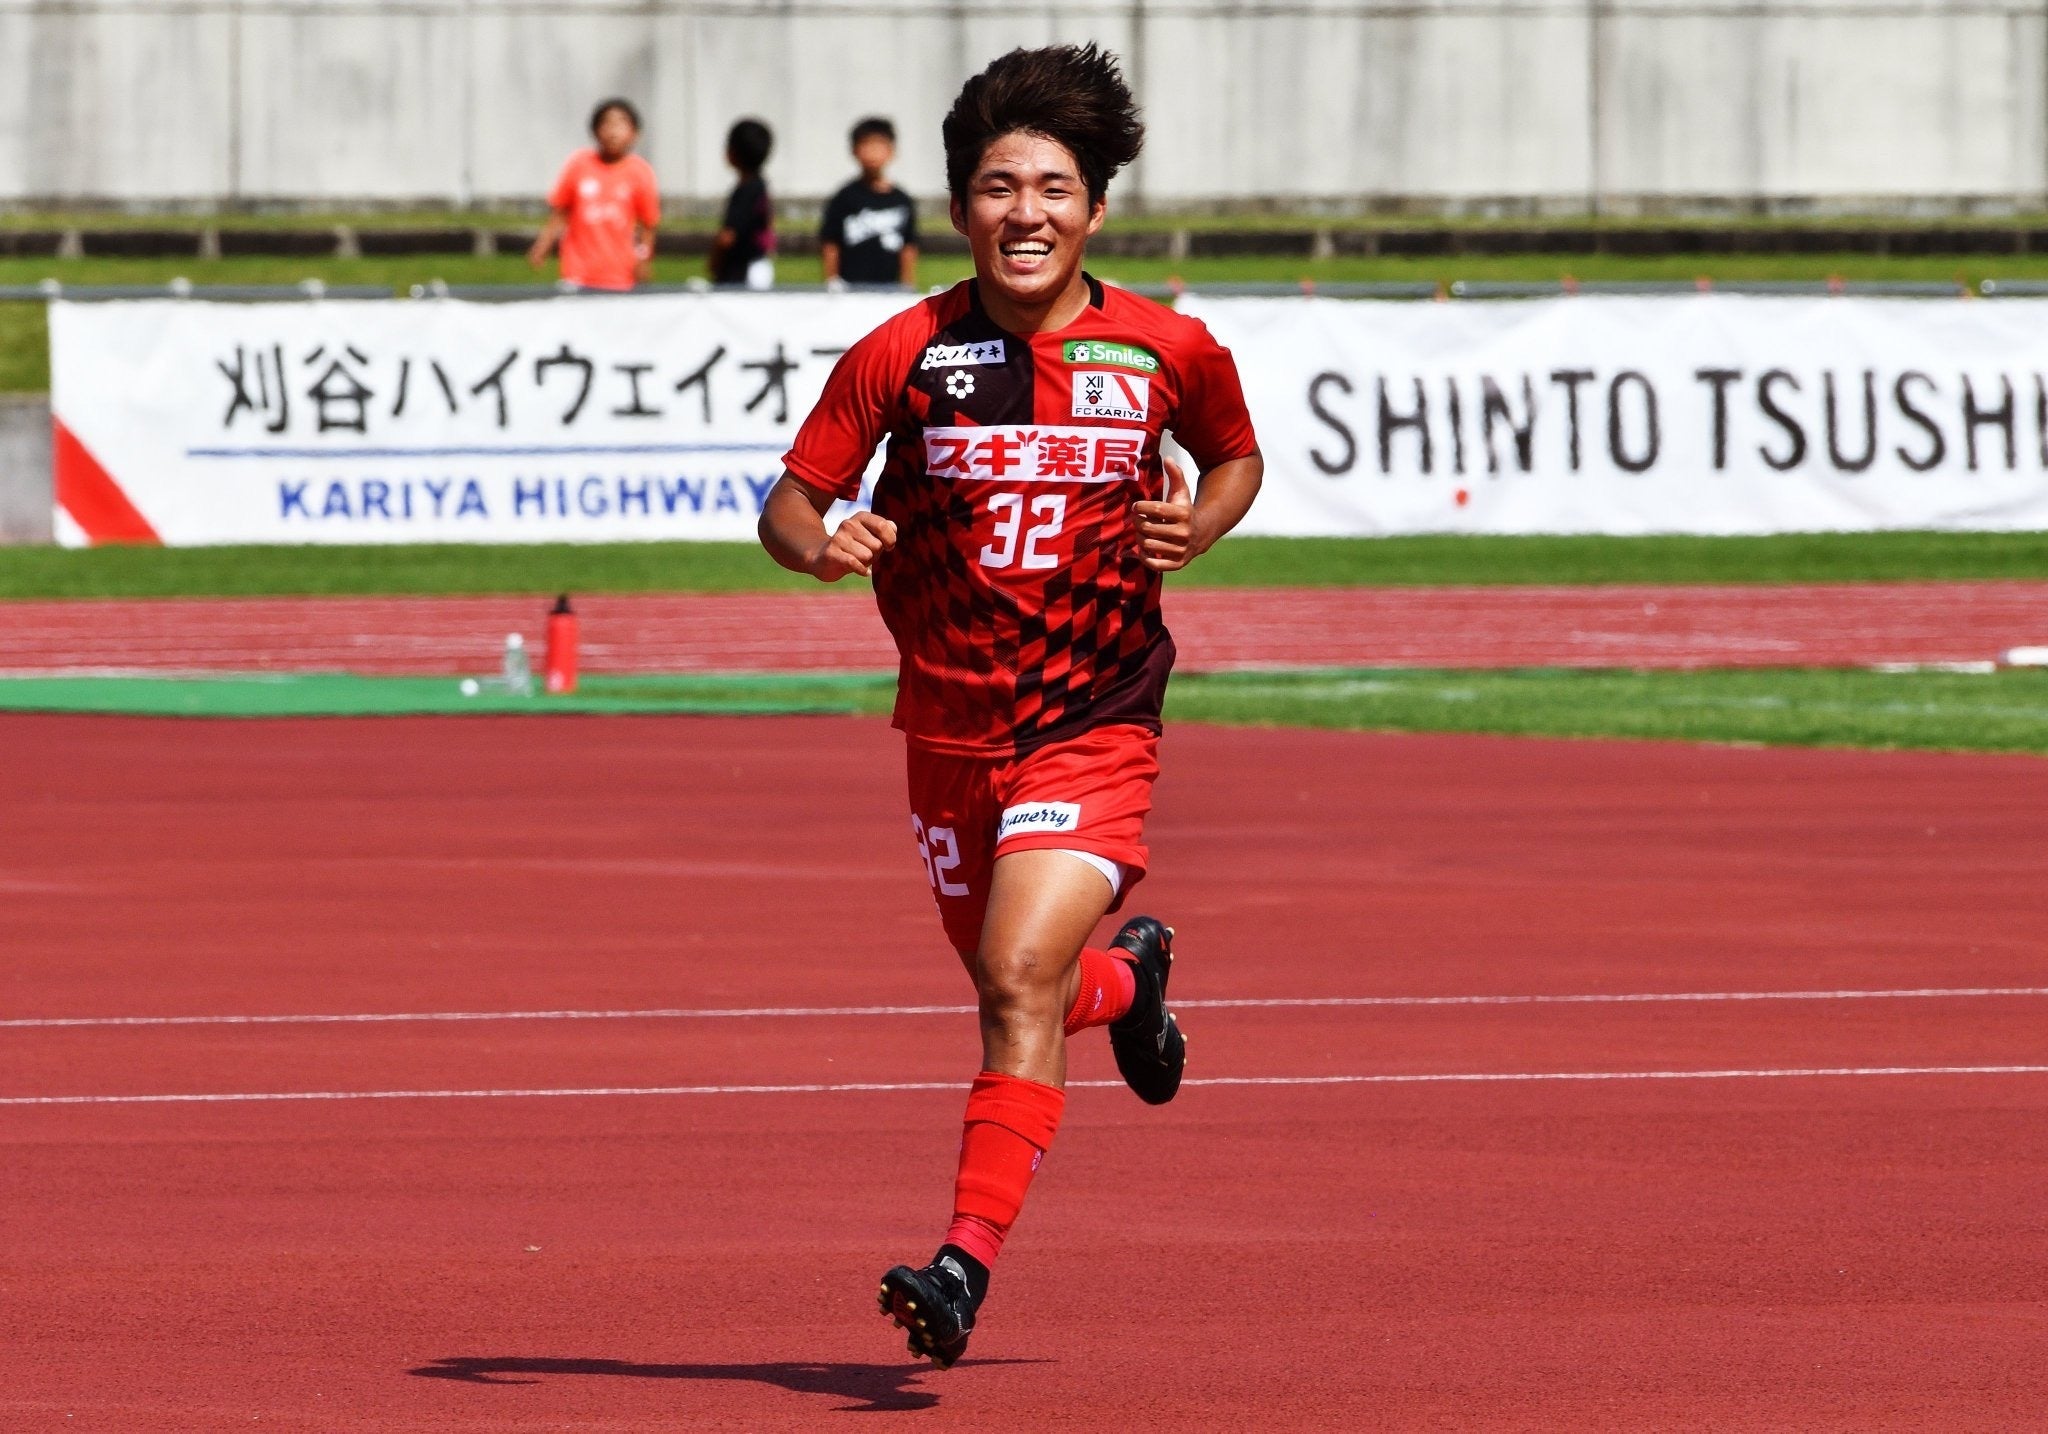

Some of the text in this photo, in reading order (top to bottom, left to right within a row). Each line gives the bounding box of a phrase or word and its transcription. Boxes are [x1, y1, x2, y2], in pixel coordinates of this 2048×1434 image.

[1092, 344, 1156, 370] Smiles
[217, 343, 848, 434] 刈谷ハイウェイオ
[1075, 407, 1144, 420] FC KARIYA
[1308, 370, 1661, 476] SHINTO
[928, 431, 1139, 477] スギ薬局
[280, 475, 776, 518] KARIYA HIGHWAY
[979, 492, 1068, 569] 32
